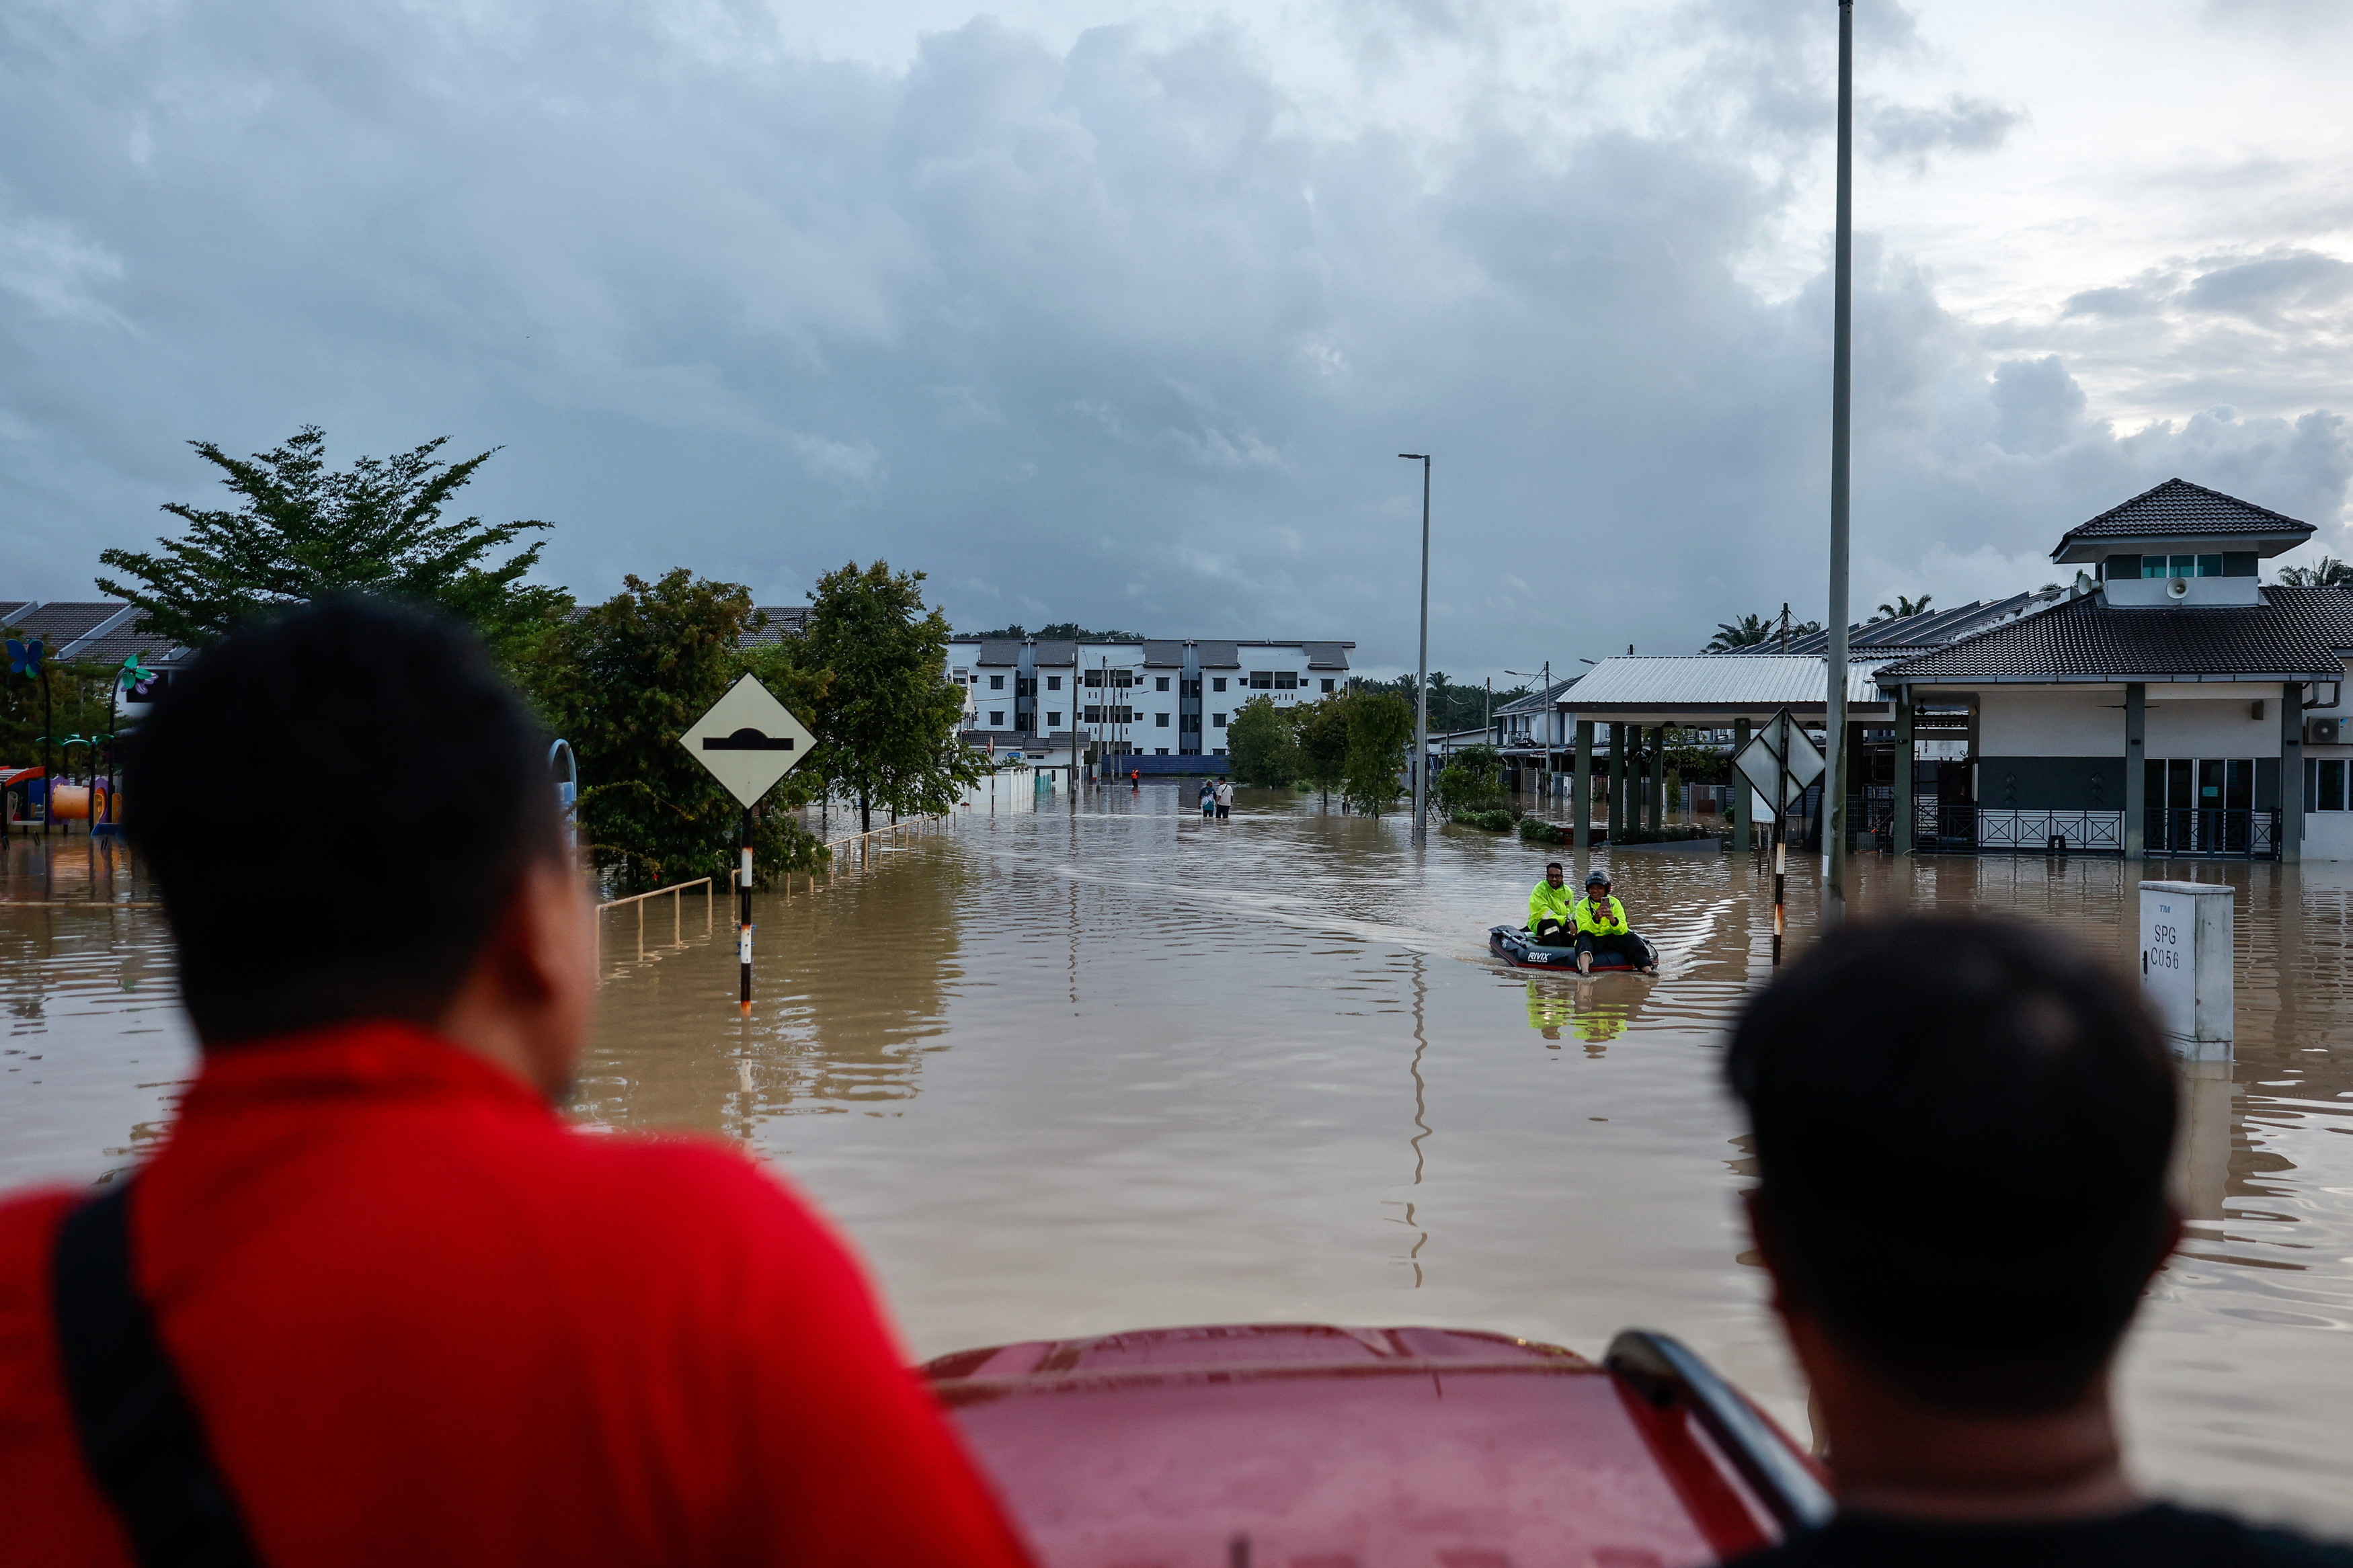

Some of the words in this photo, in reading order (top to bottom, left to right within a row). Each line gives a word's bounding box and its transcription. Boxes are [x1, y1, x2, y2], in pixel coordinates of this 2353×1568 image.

[2159, 905, 2171, 913] TM
[2155, 924, 2176, 944] SPG
[1527, 952, 1550, 960] RIVIX
[2151, 947, 2179, 969] C056
